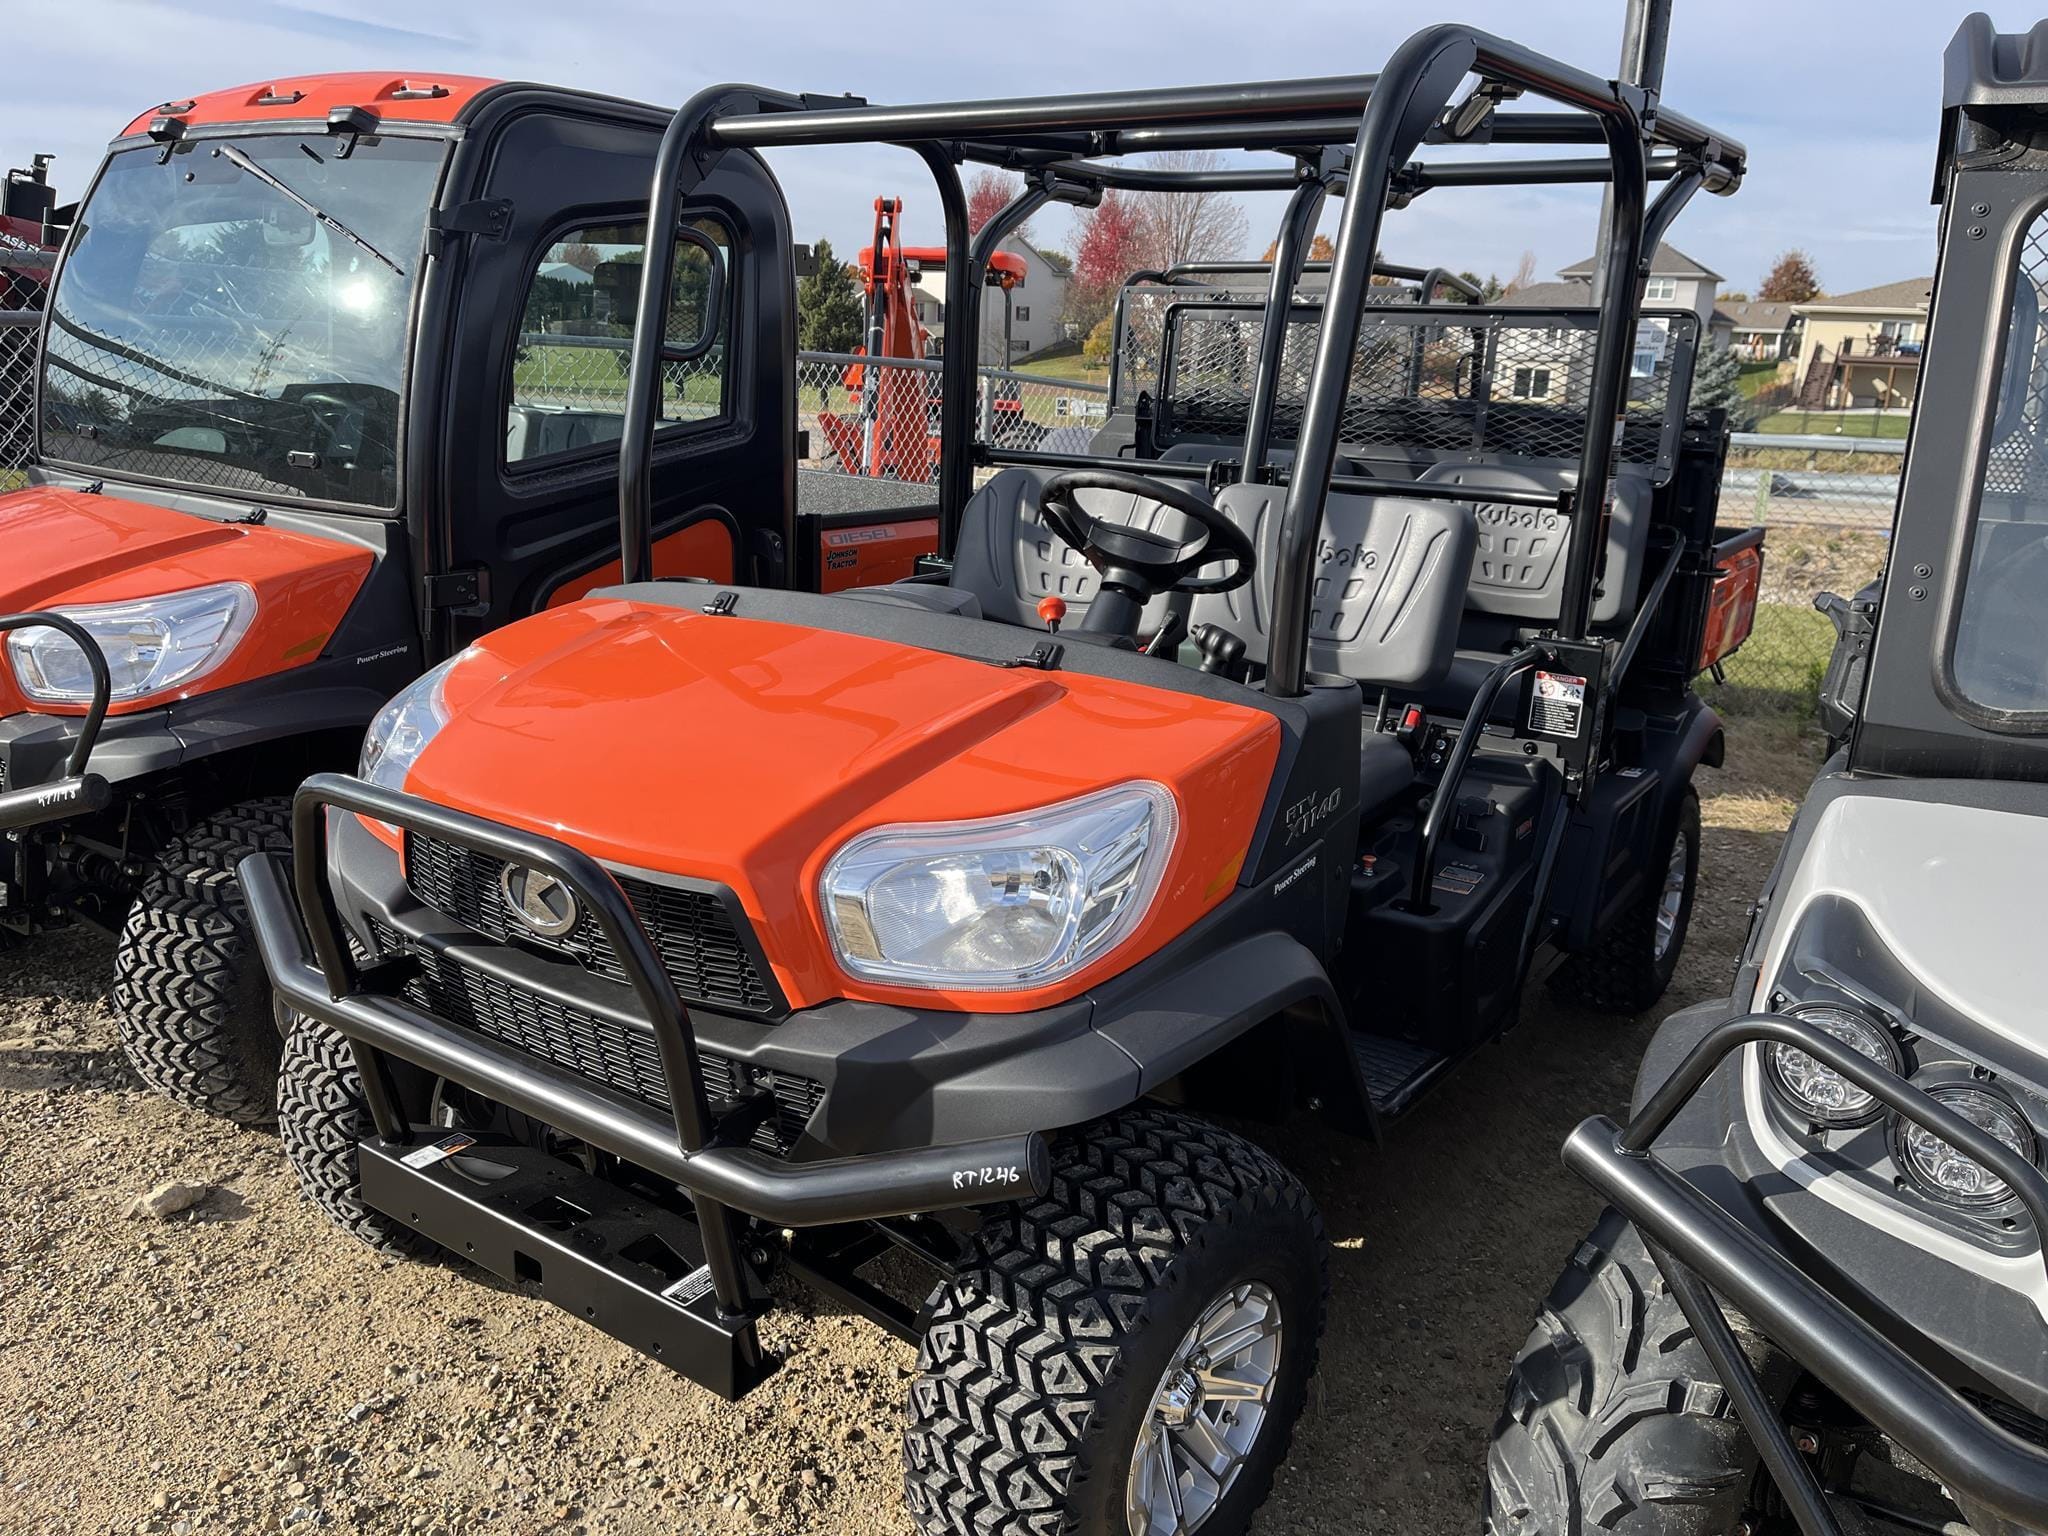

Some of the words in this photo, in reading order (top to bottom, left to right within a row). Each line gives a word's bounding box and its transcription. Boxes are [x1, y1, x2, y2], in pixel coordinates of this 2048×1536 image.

[1473, 503, 1559, 533] Kubota
[829, 528, 897, 545] DIESEL
[827, 548, 858, 562] JOHNSON
[827, 559, 858, 571] TRACTOR
[1318, 539, 1379, 571] bota
[357, 654, 379, 665] Power
[380, 645, 408, 658] Steering
[1286, 790, 1318, 824] RTV
[1273, 874, 1294, 896] Power
[1293, 856, 1317, 880] Steering
[952, 1166, 1020, 1190] RT1246
